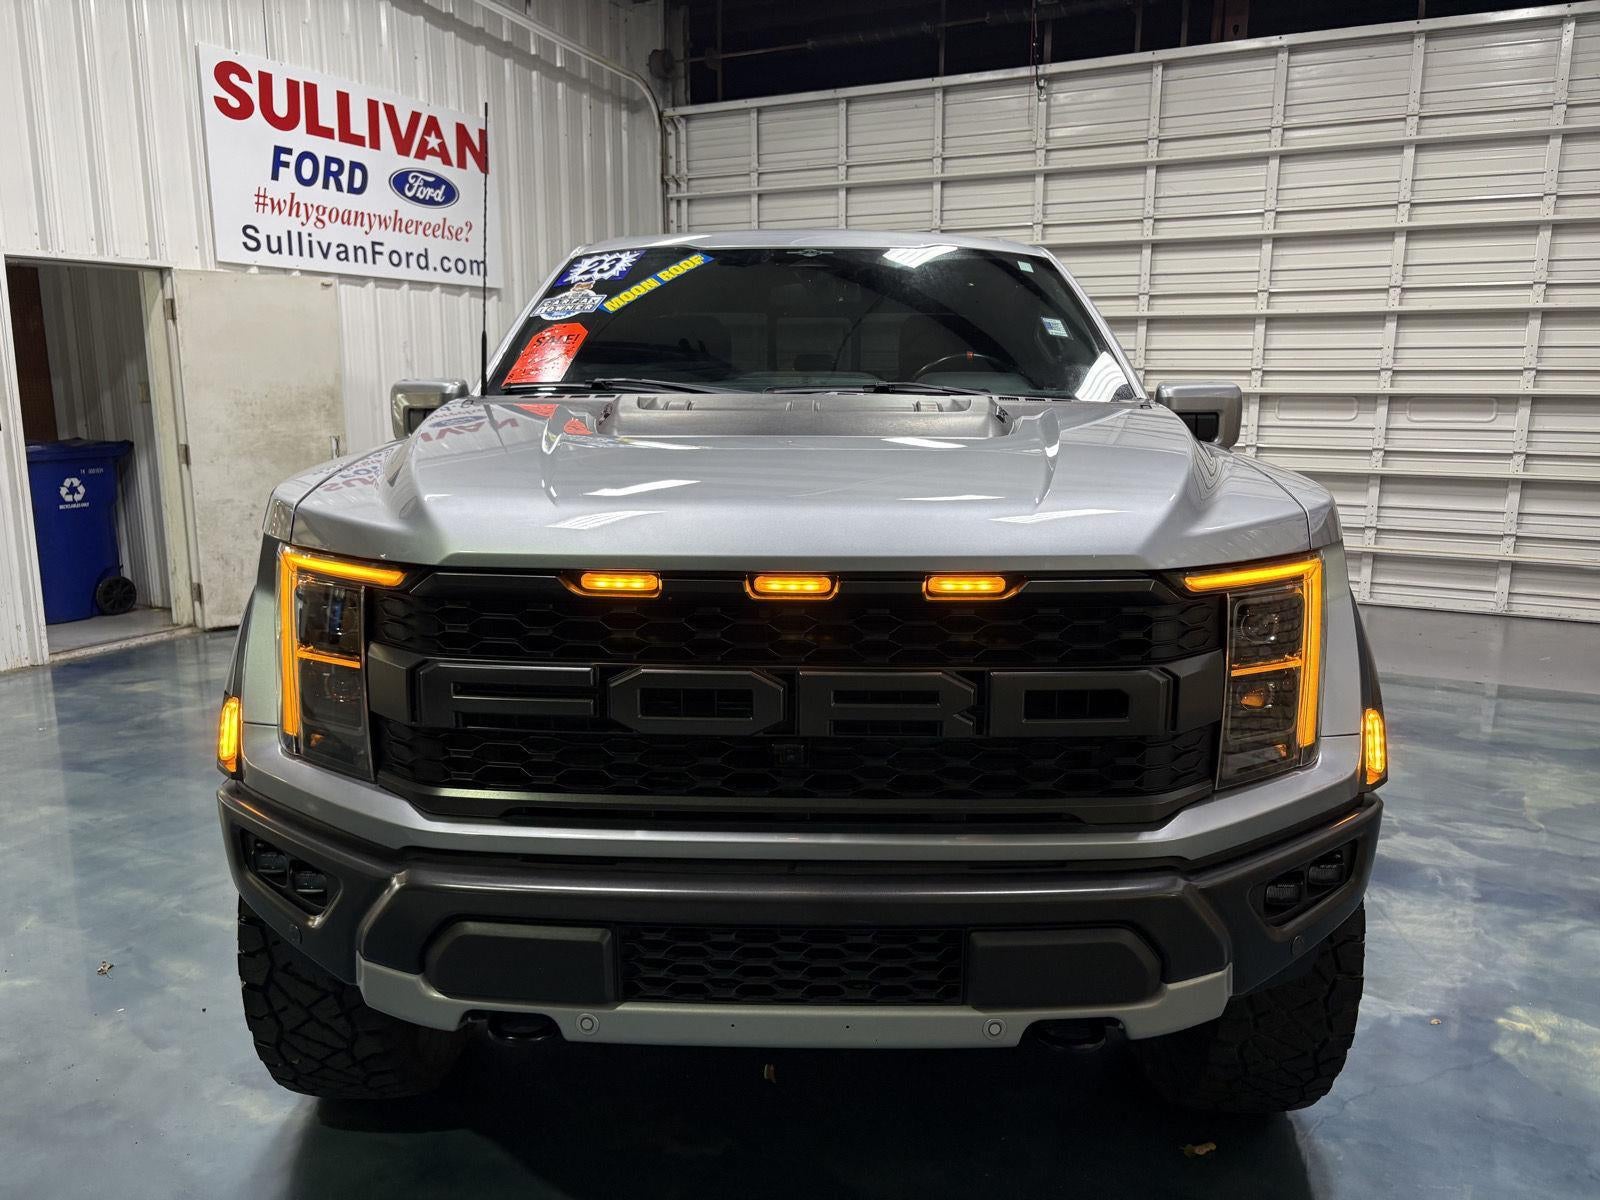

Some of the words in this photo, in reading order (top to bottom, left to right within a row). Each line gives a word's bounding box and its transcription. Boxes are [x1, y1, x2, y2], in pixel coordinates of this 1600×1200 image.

[213, 60, 489, 174] SULLIVAN
[270, 145, 369, 195] FORD
[402, 170, 447, 204] Ford
[254, 186, 473, 243] #whygoanywhereelse?
[241, 223, 487, 277] SullivanFord.com
[578, 257, 622, 277] 23
[603, 277, 661, 313] MOON
[656, 254, 705, 282] ROOF
[415, 663, 1171, 737] FORD
